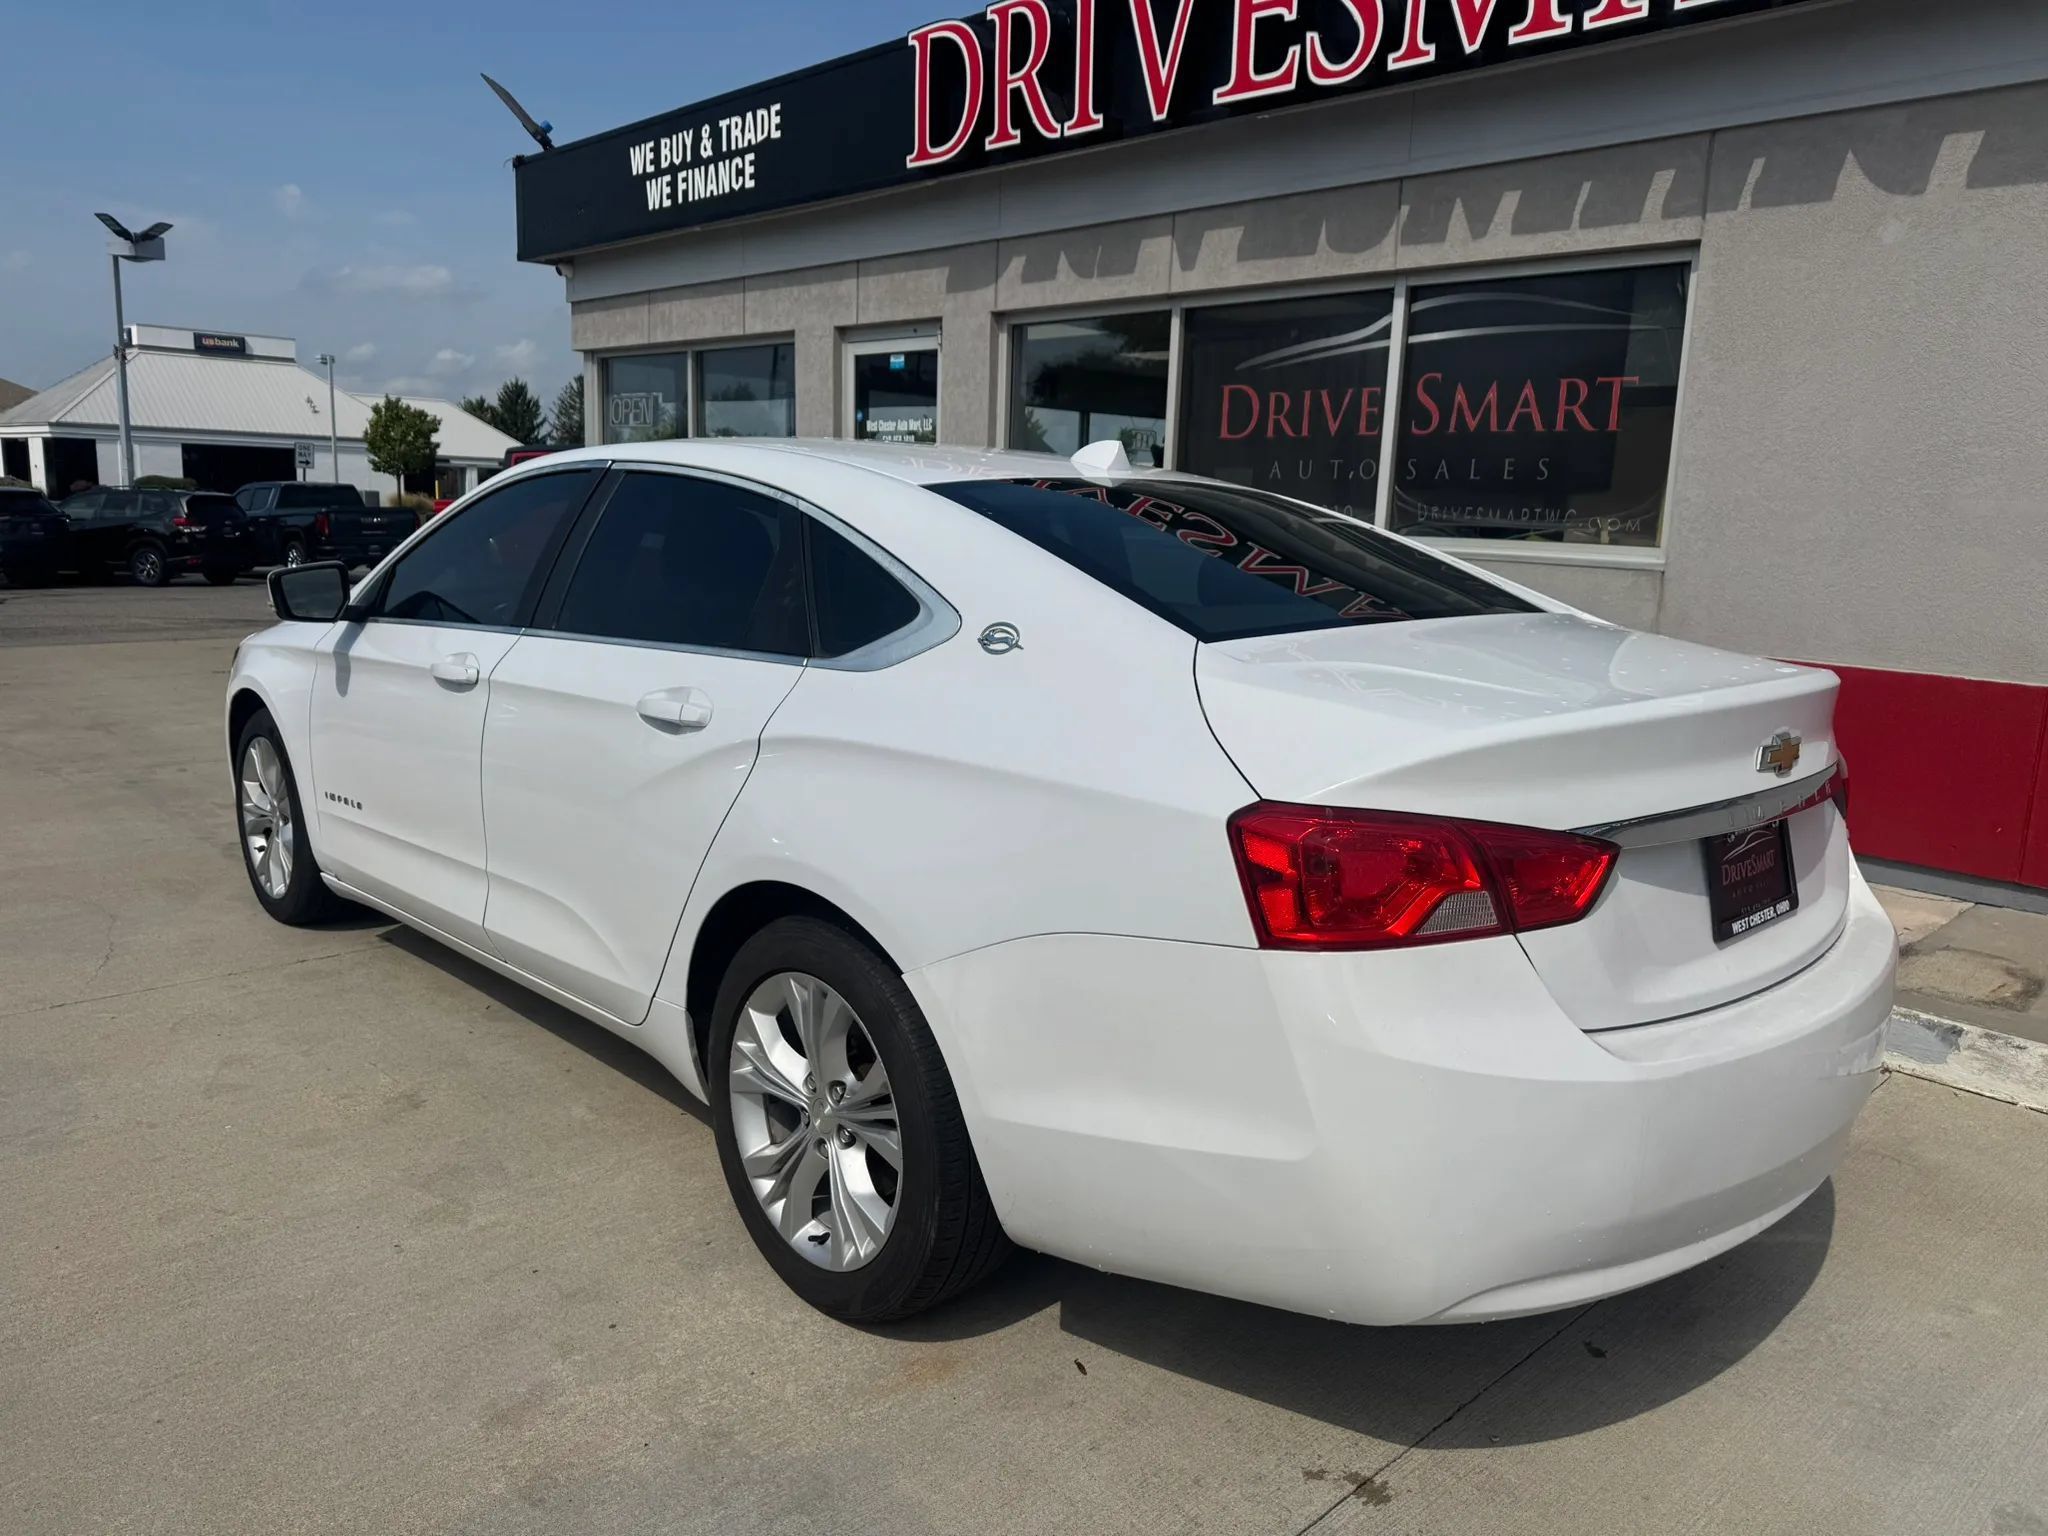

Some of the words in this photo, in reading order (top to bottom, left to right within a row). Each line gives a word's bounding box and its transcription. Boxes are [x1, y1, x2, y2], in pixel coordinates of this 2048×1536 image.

[630, 140, 655, 176] WE
[660, 128, 694, 166] BUY
[700, 123, 713, 159] &
[718, 102, 782, 152] TRADE
[646, 174, 672, 211] WE
[677, 152, 755, 204] FINANCE
[612, 397, 652, 425] OPEN
[1218, 383, 1382, 440] DRIVE
[1411, 372, 1640, 435] SMART
[1269, 458, 1376, 480] AUTO
[1406, 457, 1550, 480] SALES
[1731, 917, 1750, 935] WEST
[1749, 906, 1777, 927] CHESTER,
[1776, 899, 1791, 914] OHIO
